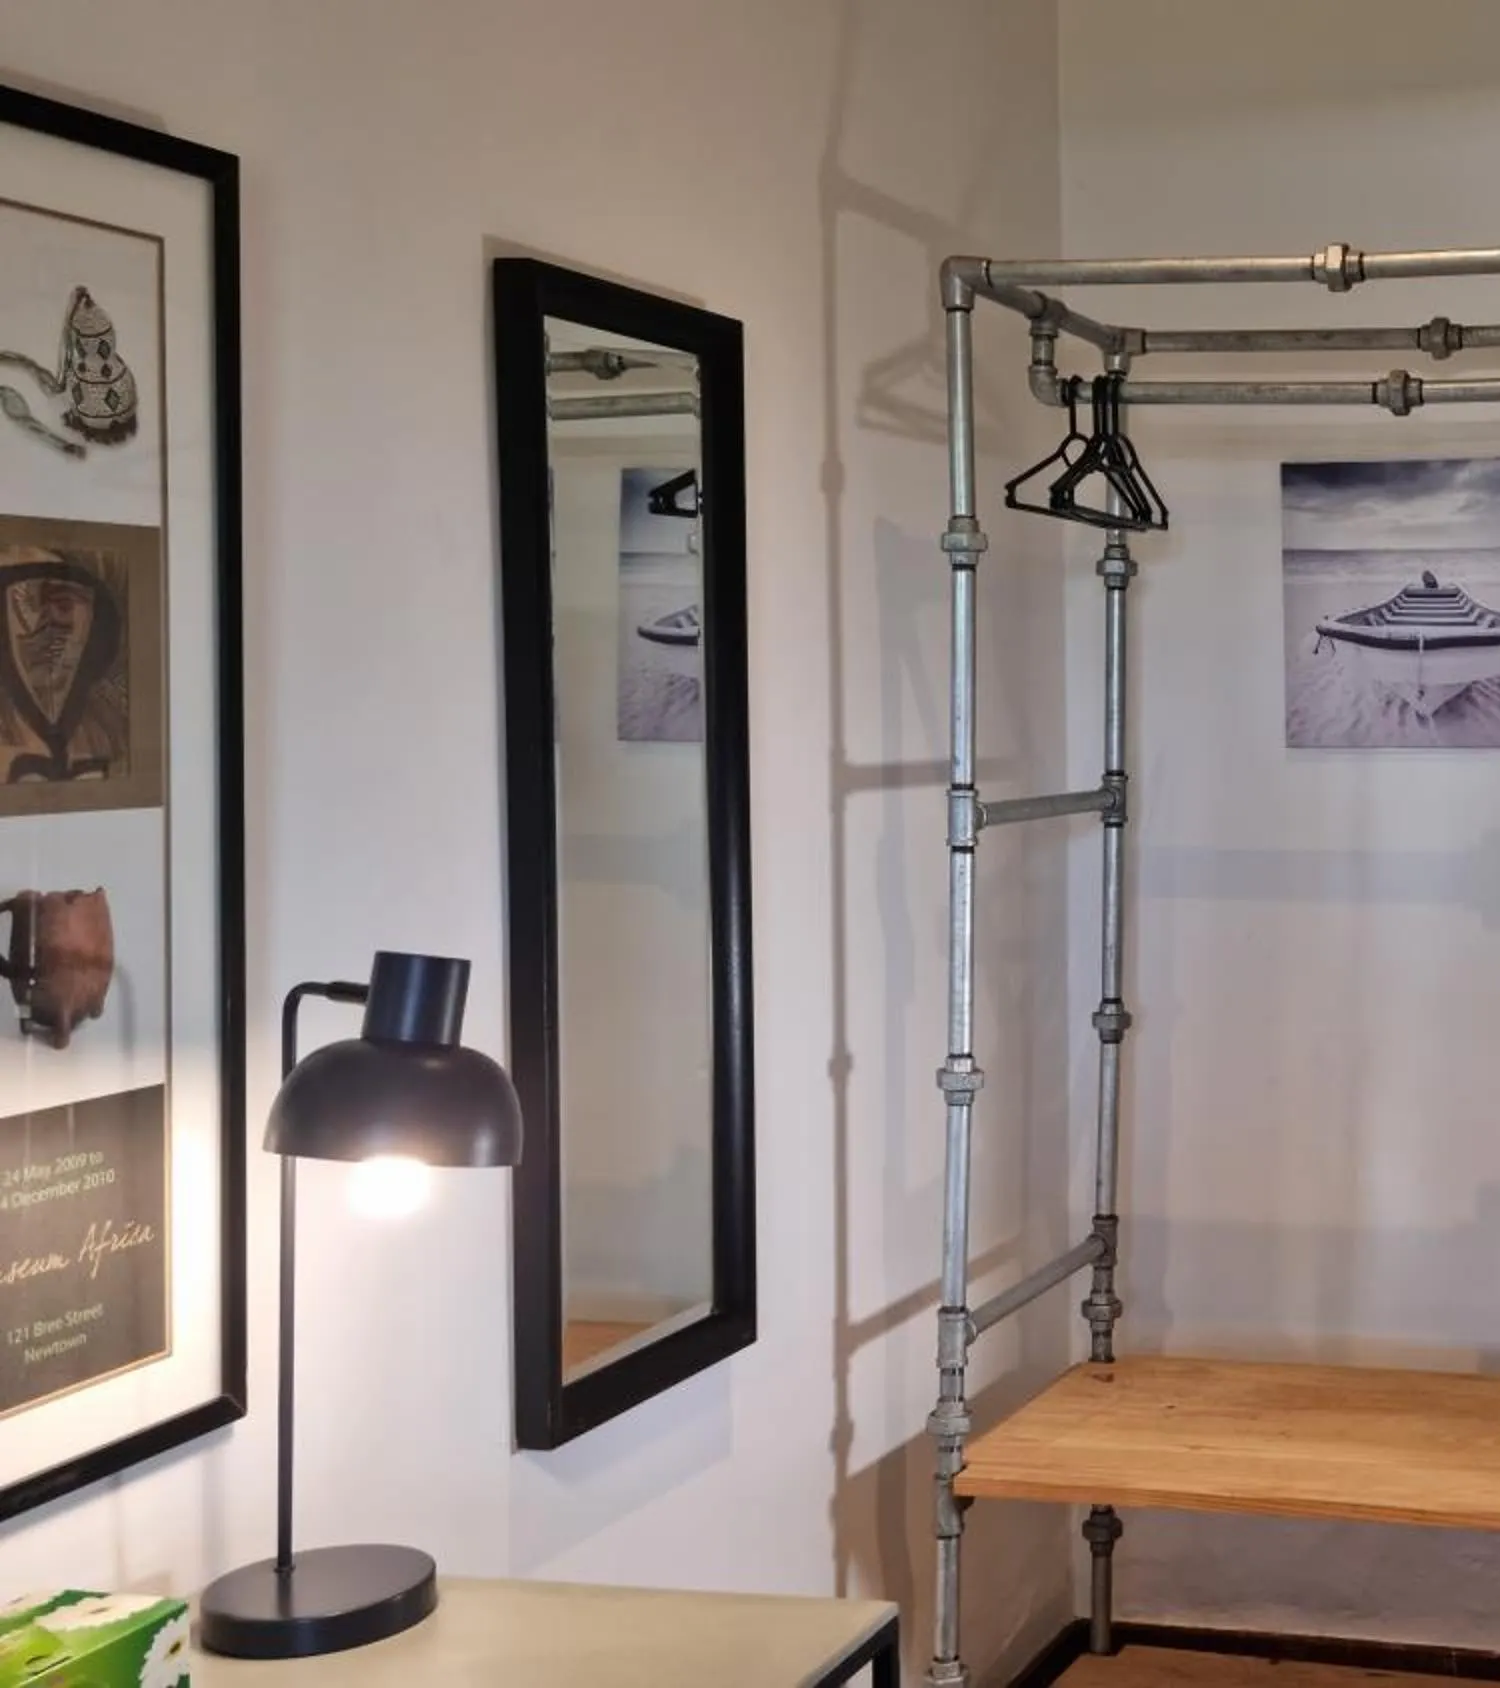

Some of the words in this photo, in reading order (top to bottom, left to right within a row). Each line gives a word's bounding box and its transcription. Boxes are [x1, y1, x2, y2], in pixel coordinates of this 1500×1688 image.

[54, 1153, 88, 1174] 2009
[89, 1151, 104, 1164] to
[11, 1180, 82, 1208] December
[83, 1168, 116, 1189] 2010
[7, 1326, 30, 1345] 121
[64, 1302, 104, 1327] Street
[24, 1333, 87, 1363] Newtown
